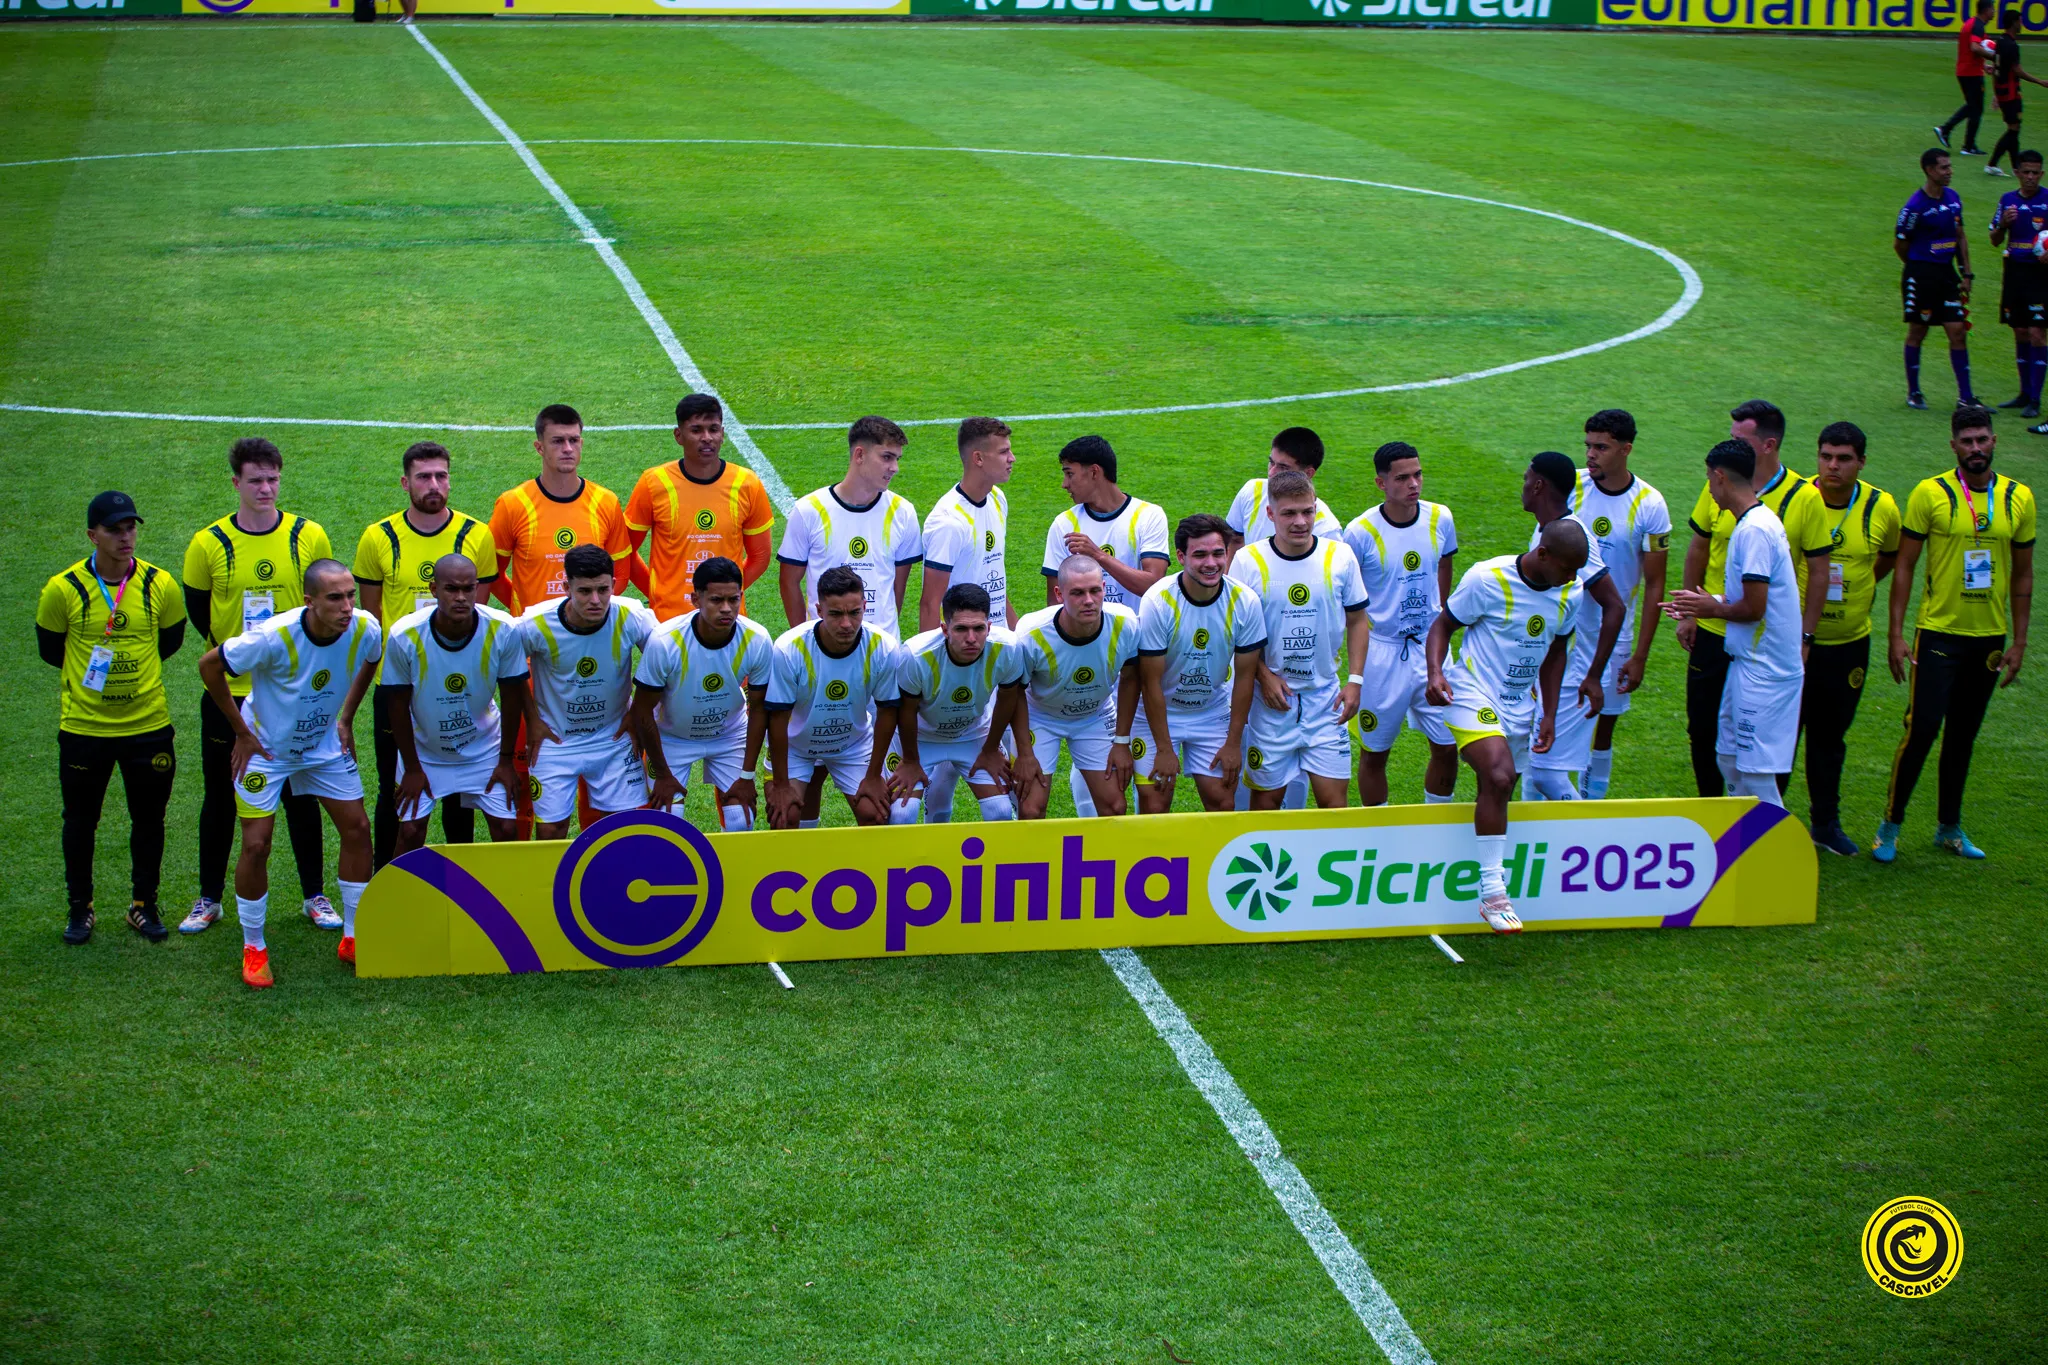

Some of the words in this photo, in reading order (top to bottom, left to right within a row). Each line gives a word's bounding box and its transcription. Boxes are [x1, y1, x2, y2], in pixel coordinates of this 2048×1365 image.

[111, 662, 139, 672] AVAN
[1508, 666, 1536, 675] HAVAN
[567, 702, 606, 712] HAVAN
[692, 710, 729, 724] HAVAN
[813, 724, 853, 735] HAVAN
[750, 835, 1189, 952] copinha
[1561, 842, 1696, 893] 2025
